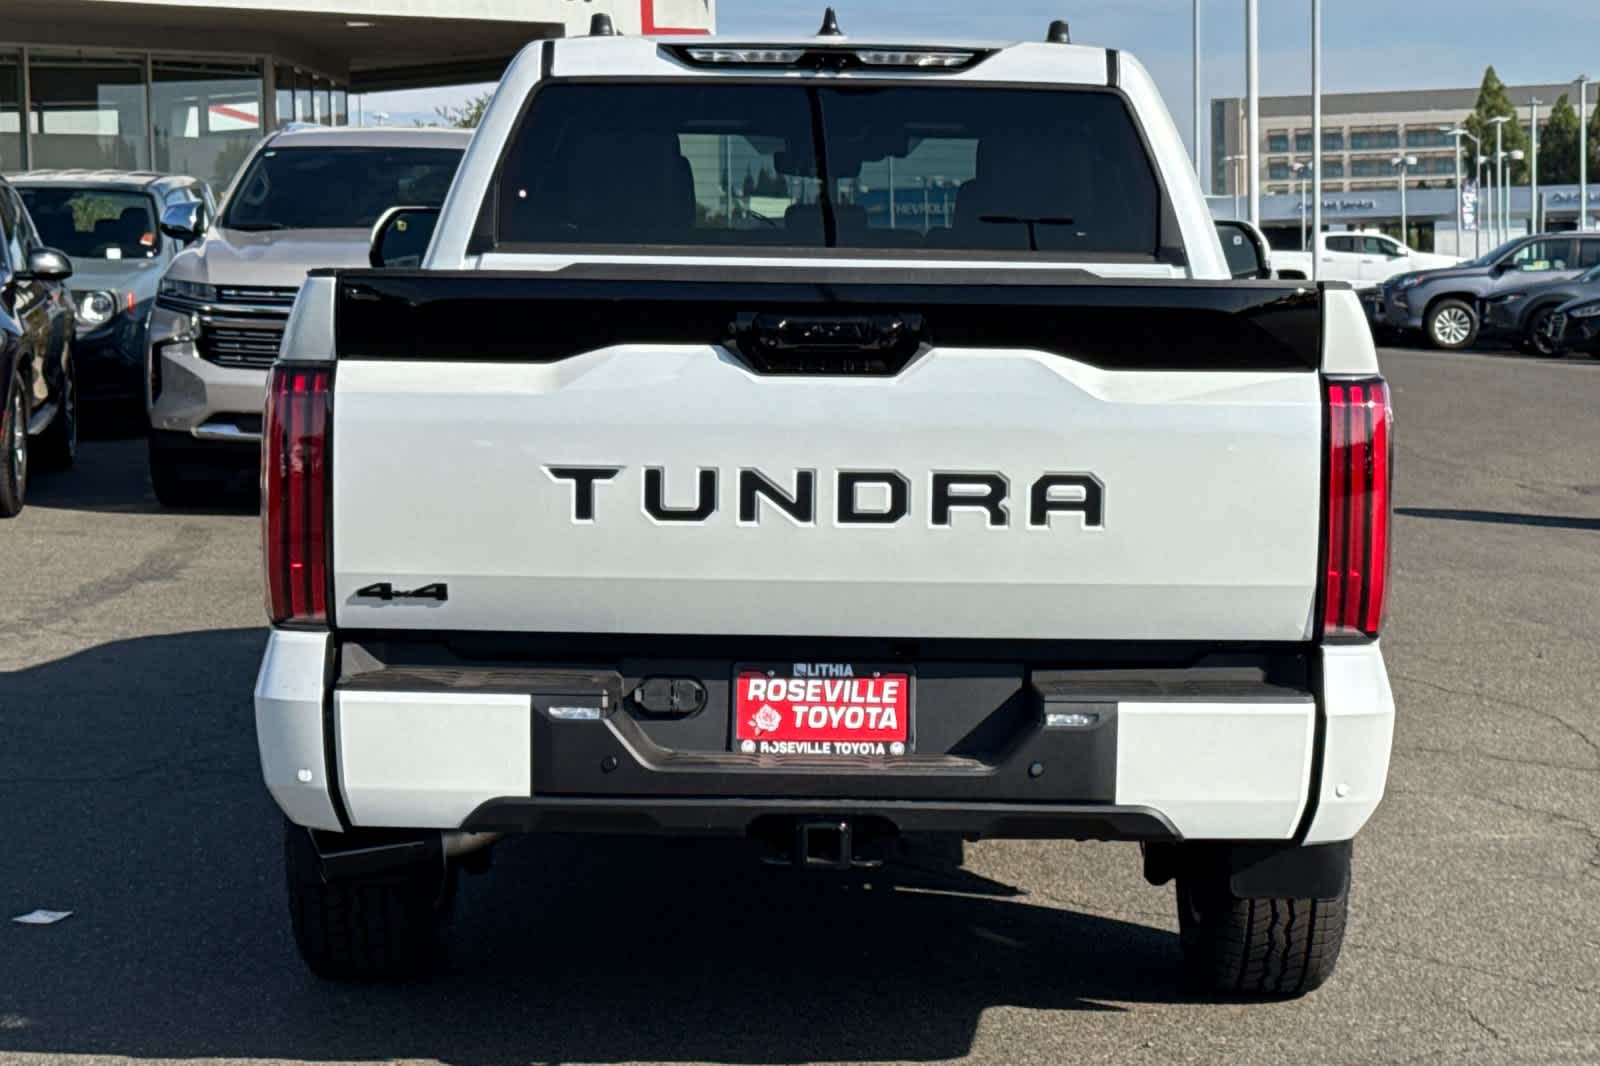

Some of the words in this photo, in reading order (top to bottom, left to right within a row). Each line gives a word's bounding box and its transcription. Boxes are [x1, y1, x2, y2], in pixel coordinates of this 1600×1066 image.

[541, 464, 1106, 530] TUNDRA
[807, 663, 853, 677] LITHIA
[747, 678, 899, 704] ROSEVILLE
[792, 705, 898, 730] TOYOTA
[760, 741, 831, 755] ROSEVILLE
[833, 742, 886, 755] TOYOTA
